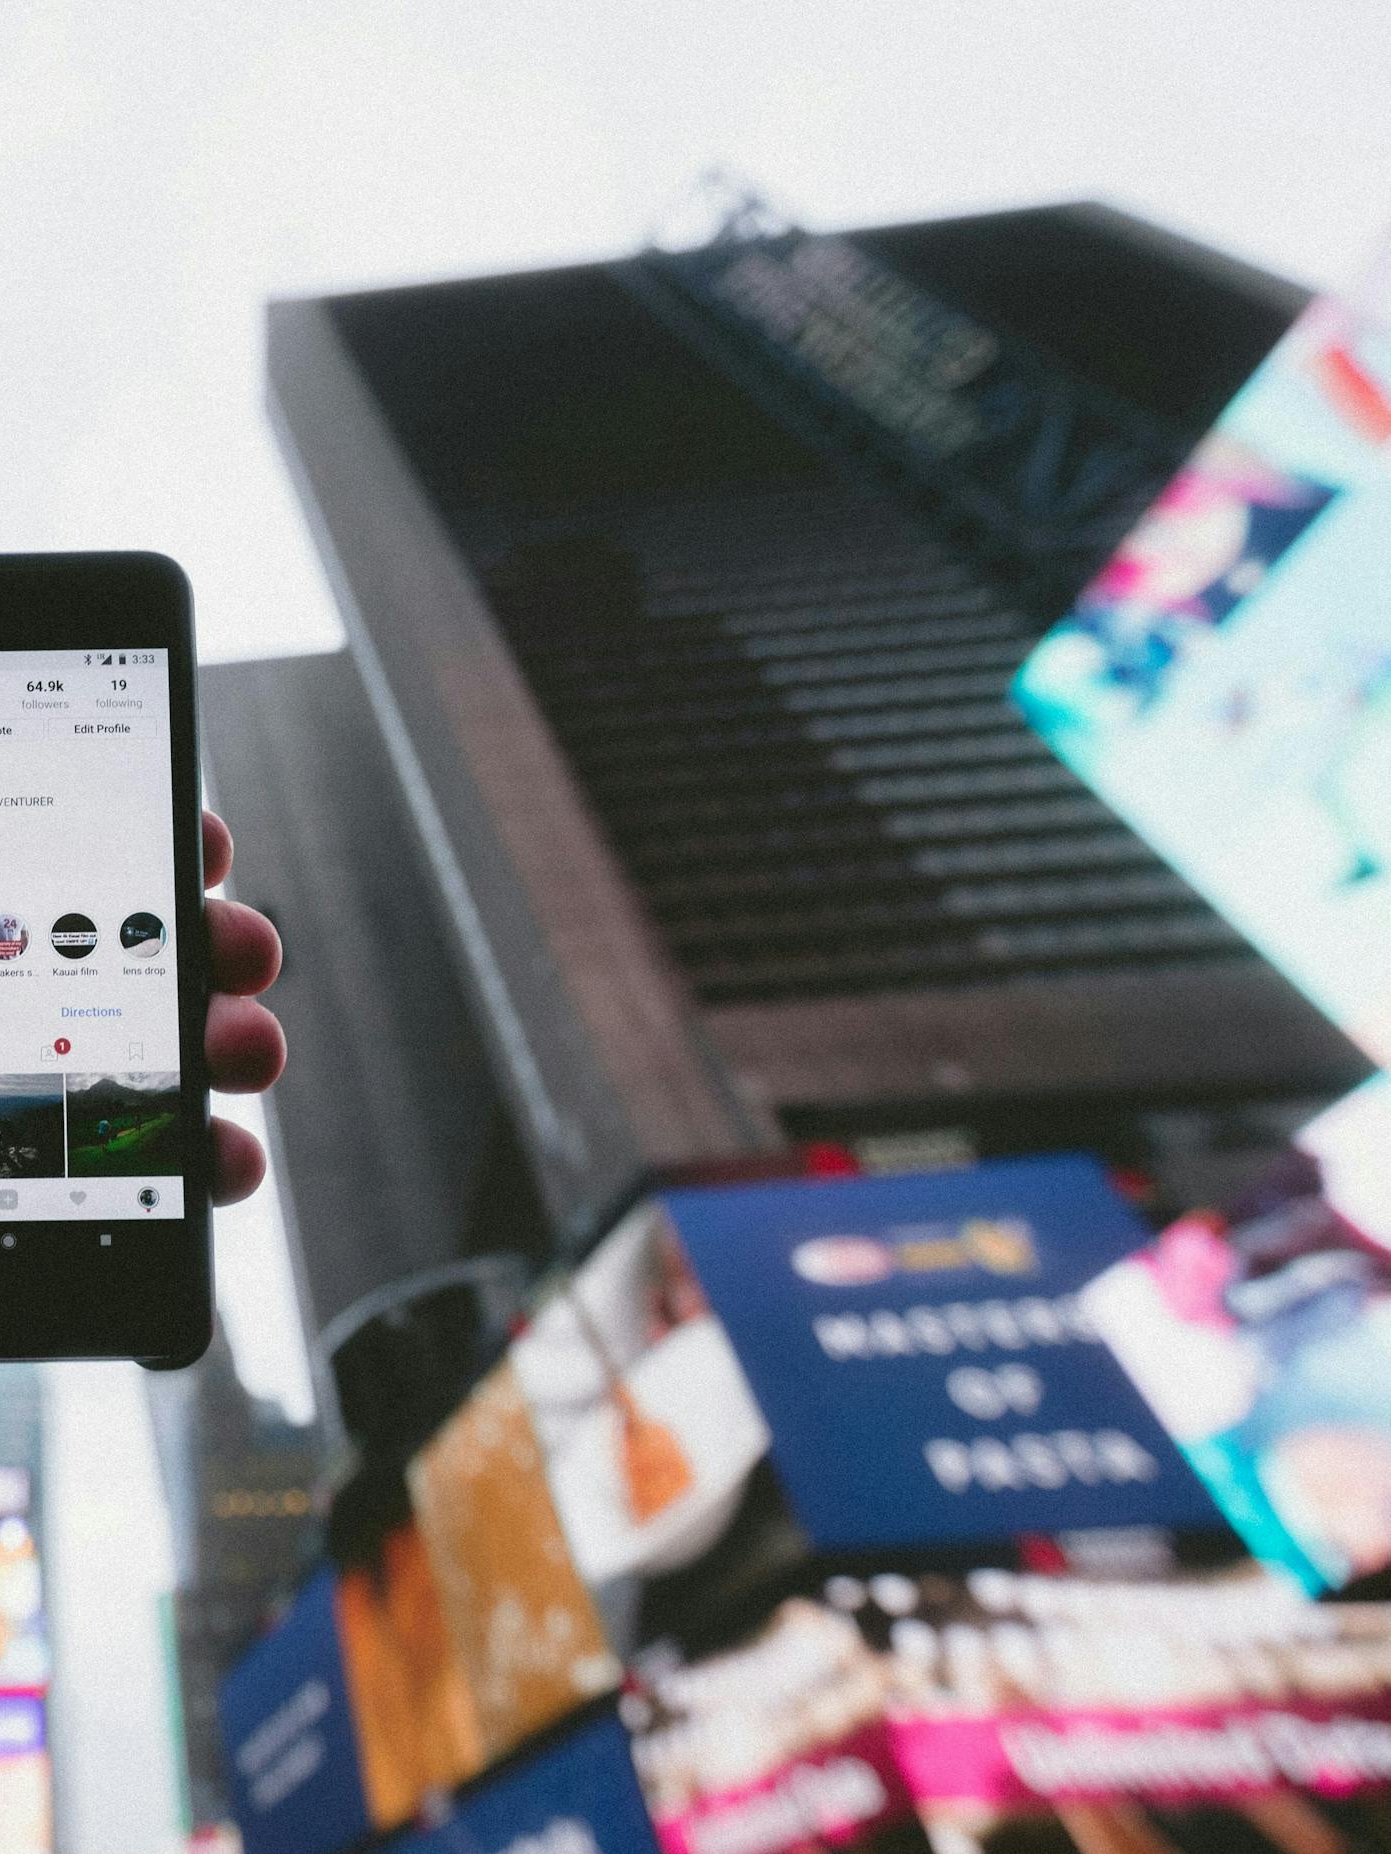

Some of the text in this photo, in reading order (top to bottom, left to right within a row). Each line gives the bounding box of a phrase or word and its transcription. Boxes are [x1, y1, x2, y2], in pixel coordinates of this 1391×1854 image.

[132, 654, 155, 664] 3:33
[26, 680, 64, 692] 64.9k
[111, 679, 127, 691] 19
[22, 699, 70, 710] followers
[96, 698, 143, 710] following
[74, 724, 130, 734] Edit Profile
[3, 918, 17, 929] 24
[52, 966, 98, 977] Kauai film
[123, 965, 166, 977] lens drop
[61, 1006, 122, 1018] Directions
